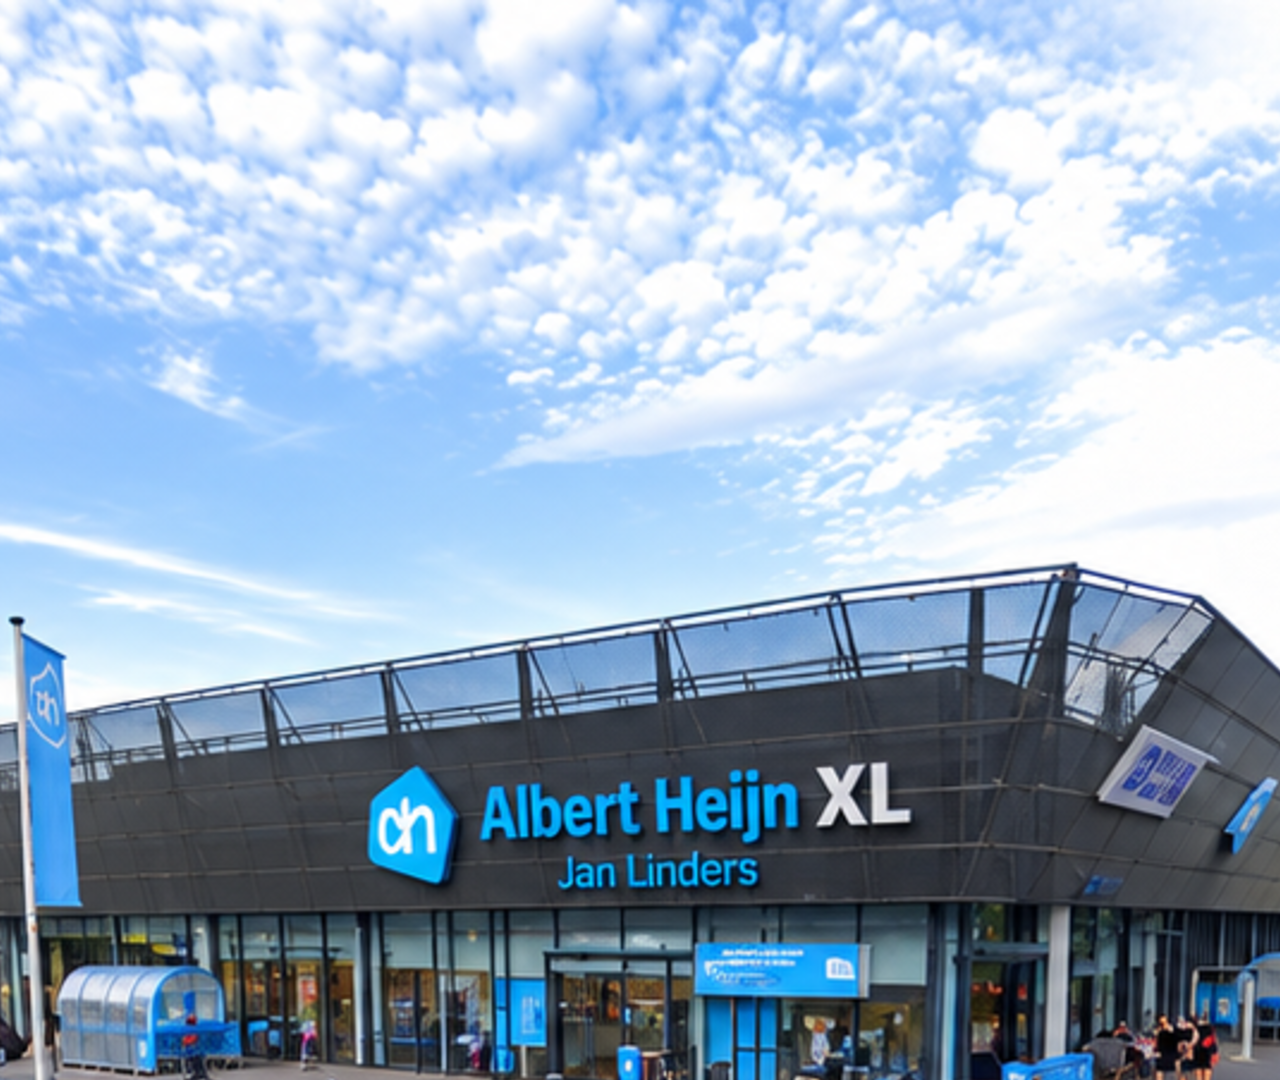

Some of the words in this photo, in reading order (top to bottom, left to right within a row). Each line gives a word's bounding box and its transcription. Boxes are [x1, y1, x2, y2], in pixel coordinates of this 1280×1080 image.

[480, 783, 642, 841] Albert
[655, 769, 799, 844] Heijn
[815, 762, 912, 828] XL
[557, 855, 617, 890] Jan
[626, 851, 759, 888] Linders
